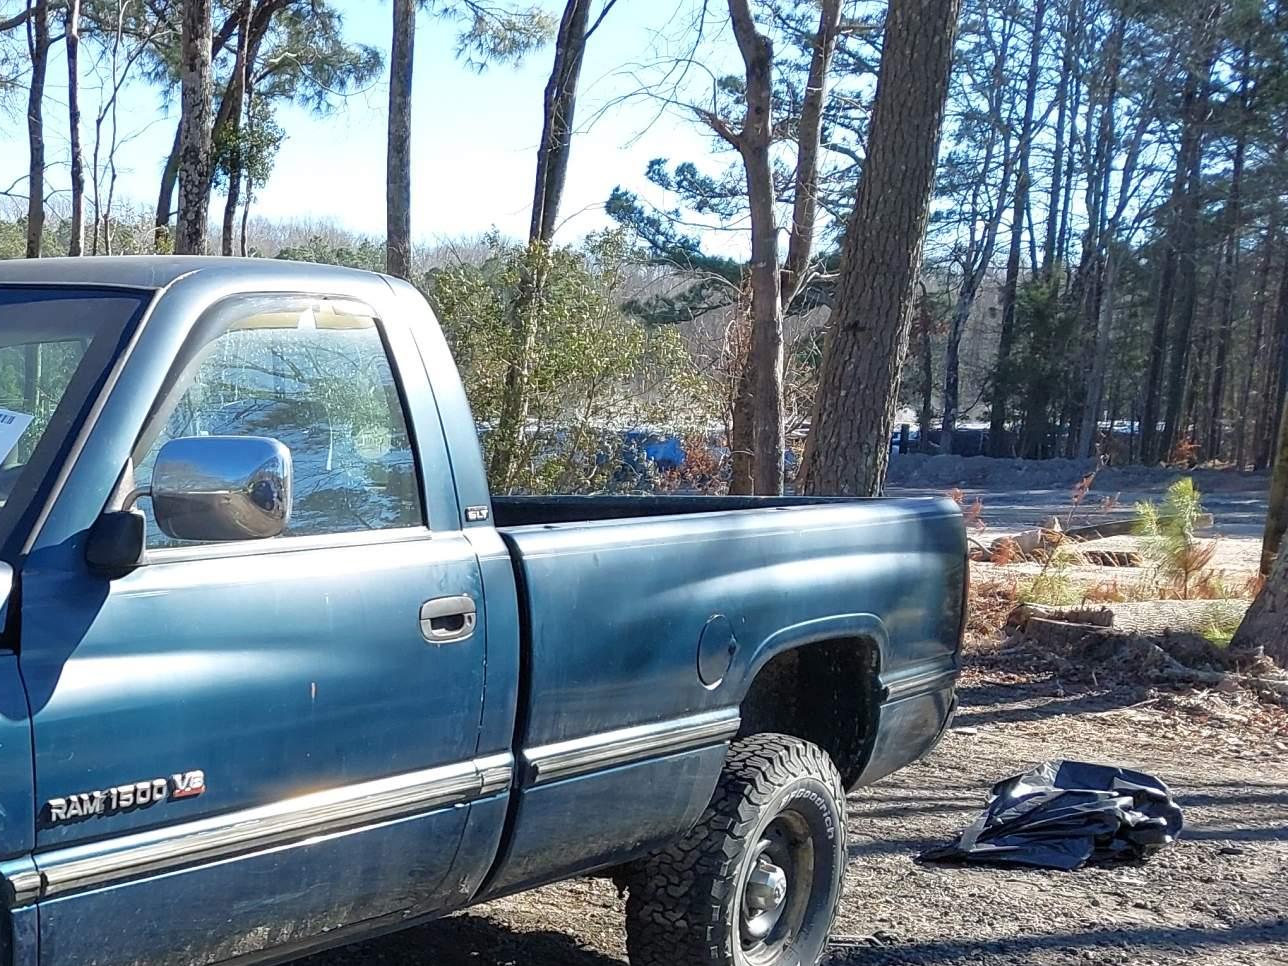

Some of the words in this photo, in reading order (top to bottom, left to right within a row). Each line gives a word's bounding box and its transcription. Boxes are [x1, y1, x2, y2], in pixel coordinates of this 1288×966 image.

[47, 790, 106, 822] RAM
[109, 778, 167, 810] 1500
[171, 769, 206, 797] V8
